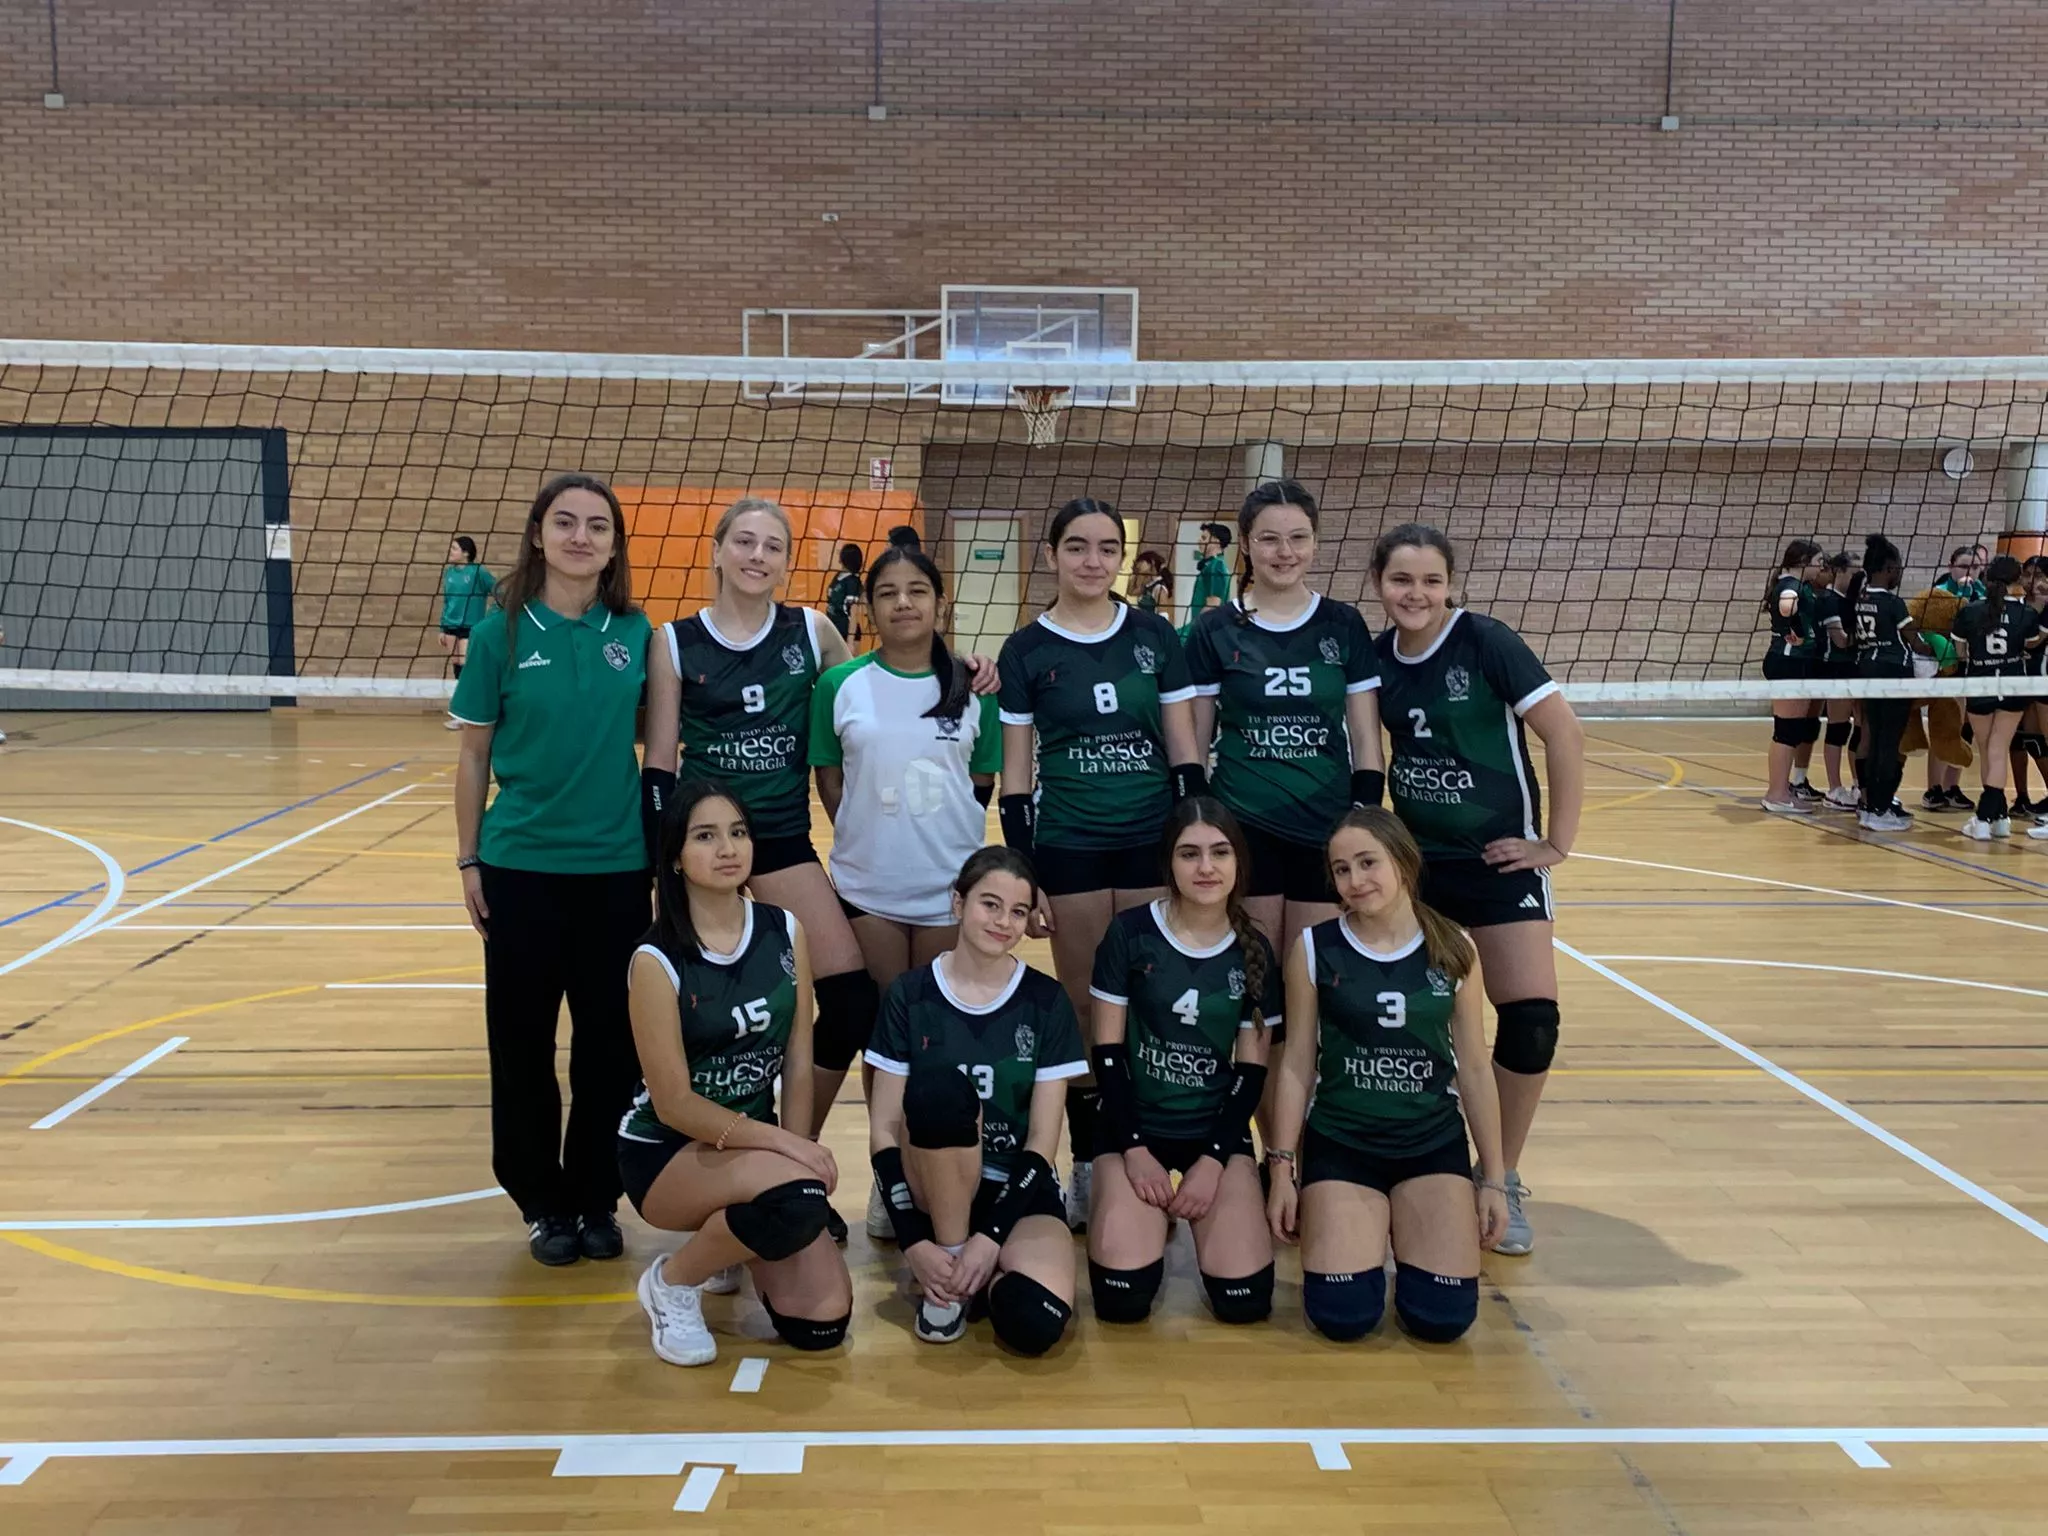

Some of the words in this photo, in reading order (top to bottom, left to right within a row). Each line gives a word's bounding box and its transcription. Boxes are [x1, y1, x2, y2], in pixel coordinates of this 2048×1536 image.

[1985, 628, 2008, 655] 6
[1264, 666, 1312, 697] 25
[741, 684, 765, 713] 9
[1093, 682, 1119, 714] 8
[1408, 708, 1433, 738] 2
[731, 997, 772, 1040] 15
[1171, 988, 1200, 1026] 4
[1376, 991, 1407, 1028] 3
[1136, 1042, 1218, 1076] Huesca
[1344, 1056, 1434, 1080] Huesca
